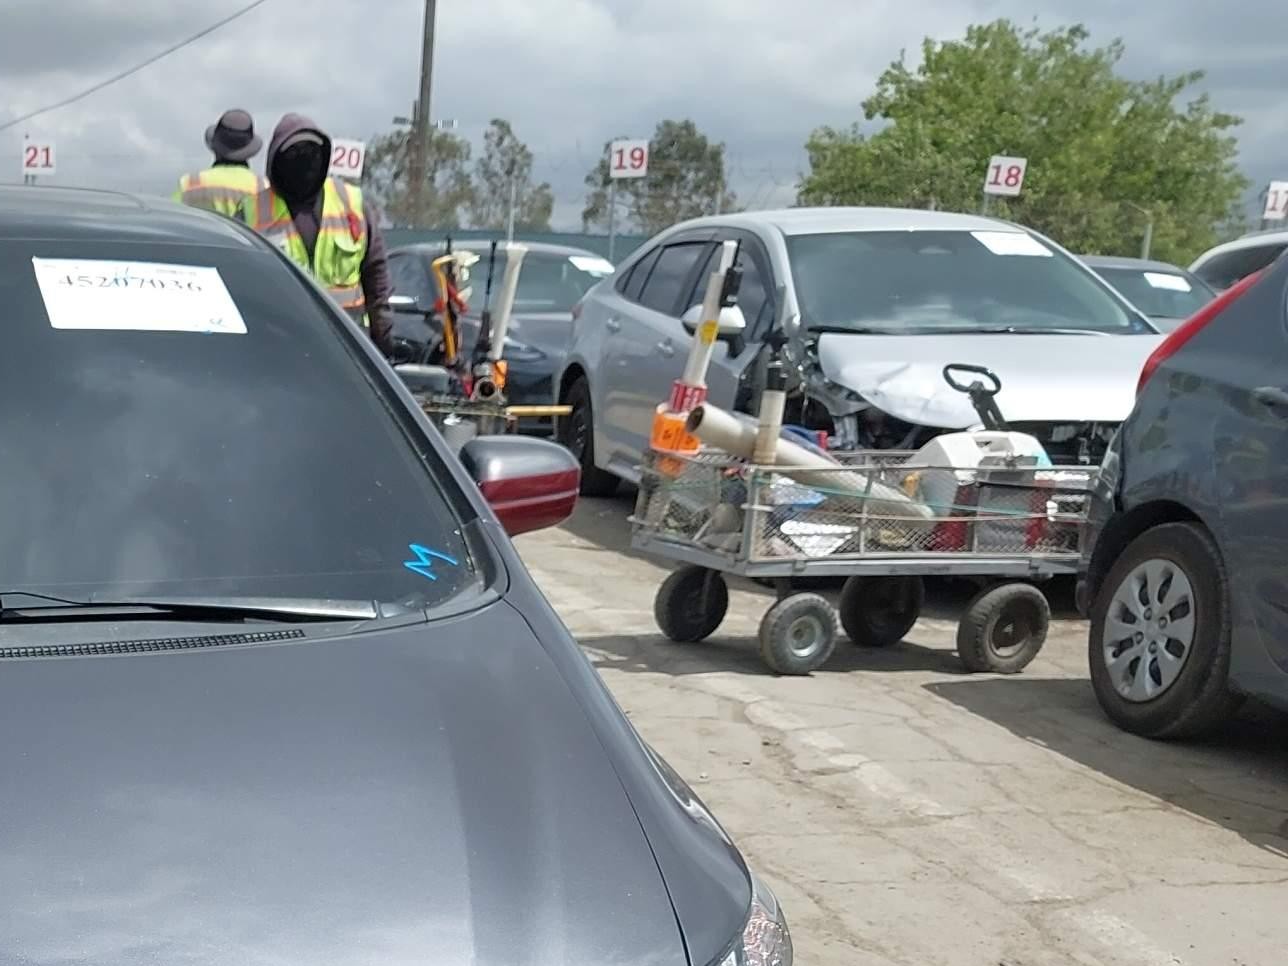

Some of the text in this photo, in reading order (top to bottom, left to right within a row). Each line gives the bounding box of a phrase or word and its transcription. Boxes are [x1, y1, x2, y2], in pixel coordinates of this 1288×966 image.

[25, 146, 54, 168] 21
[333, 146, 360, 168] 20
[613, 148, 644, 169] 19
[988, 164, 1021, 187] 18
